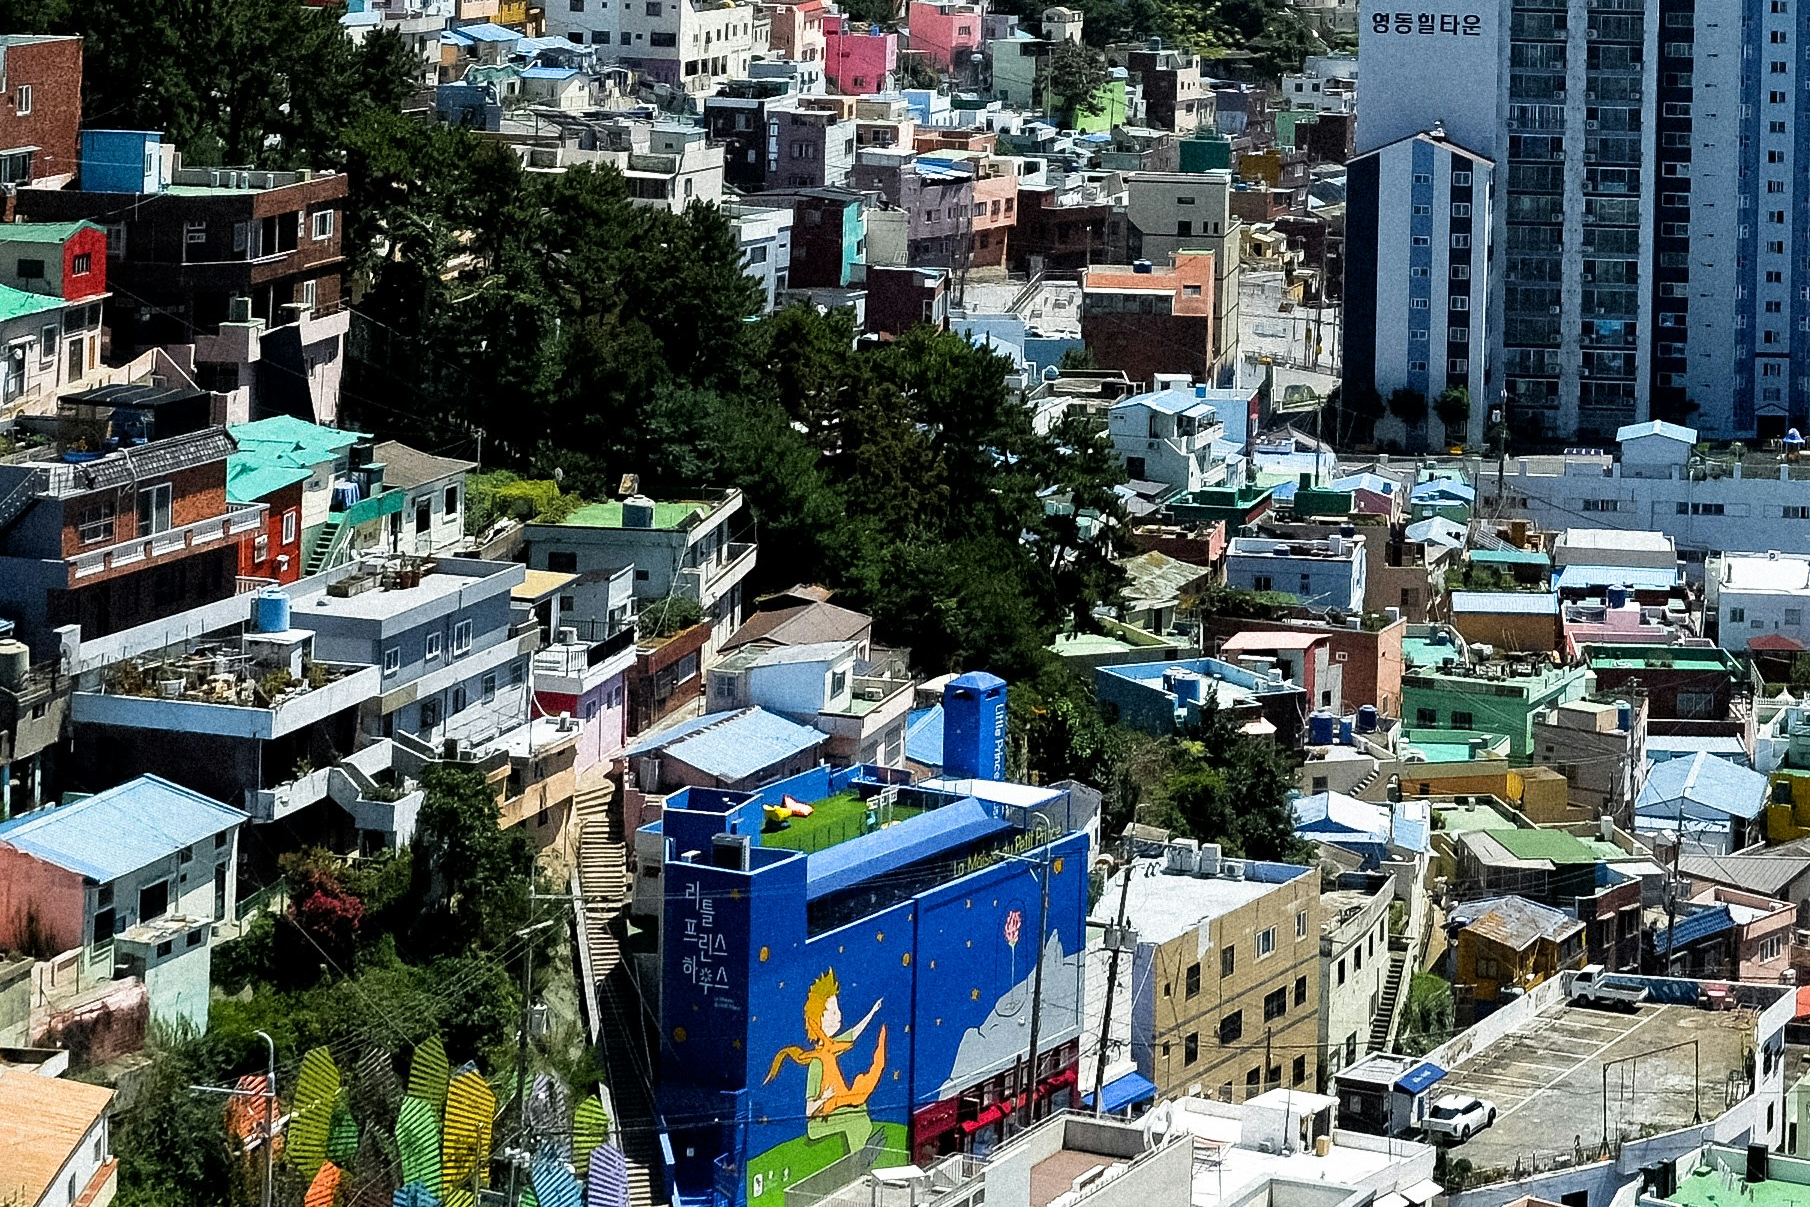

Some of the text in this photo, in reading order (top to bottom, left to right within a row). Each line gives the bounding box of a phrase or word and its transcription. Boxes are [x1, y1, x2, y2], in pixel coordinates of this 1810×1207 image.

[1372, 12, 1482, 36] 영동힐타운
[1014, 830, 1036, 854] Petit
[685, 881, 716, 927] 리틀
[683, 919, 728, 962] 프린스
[682, 955, 729, 995] 하우스
